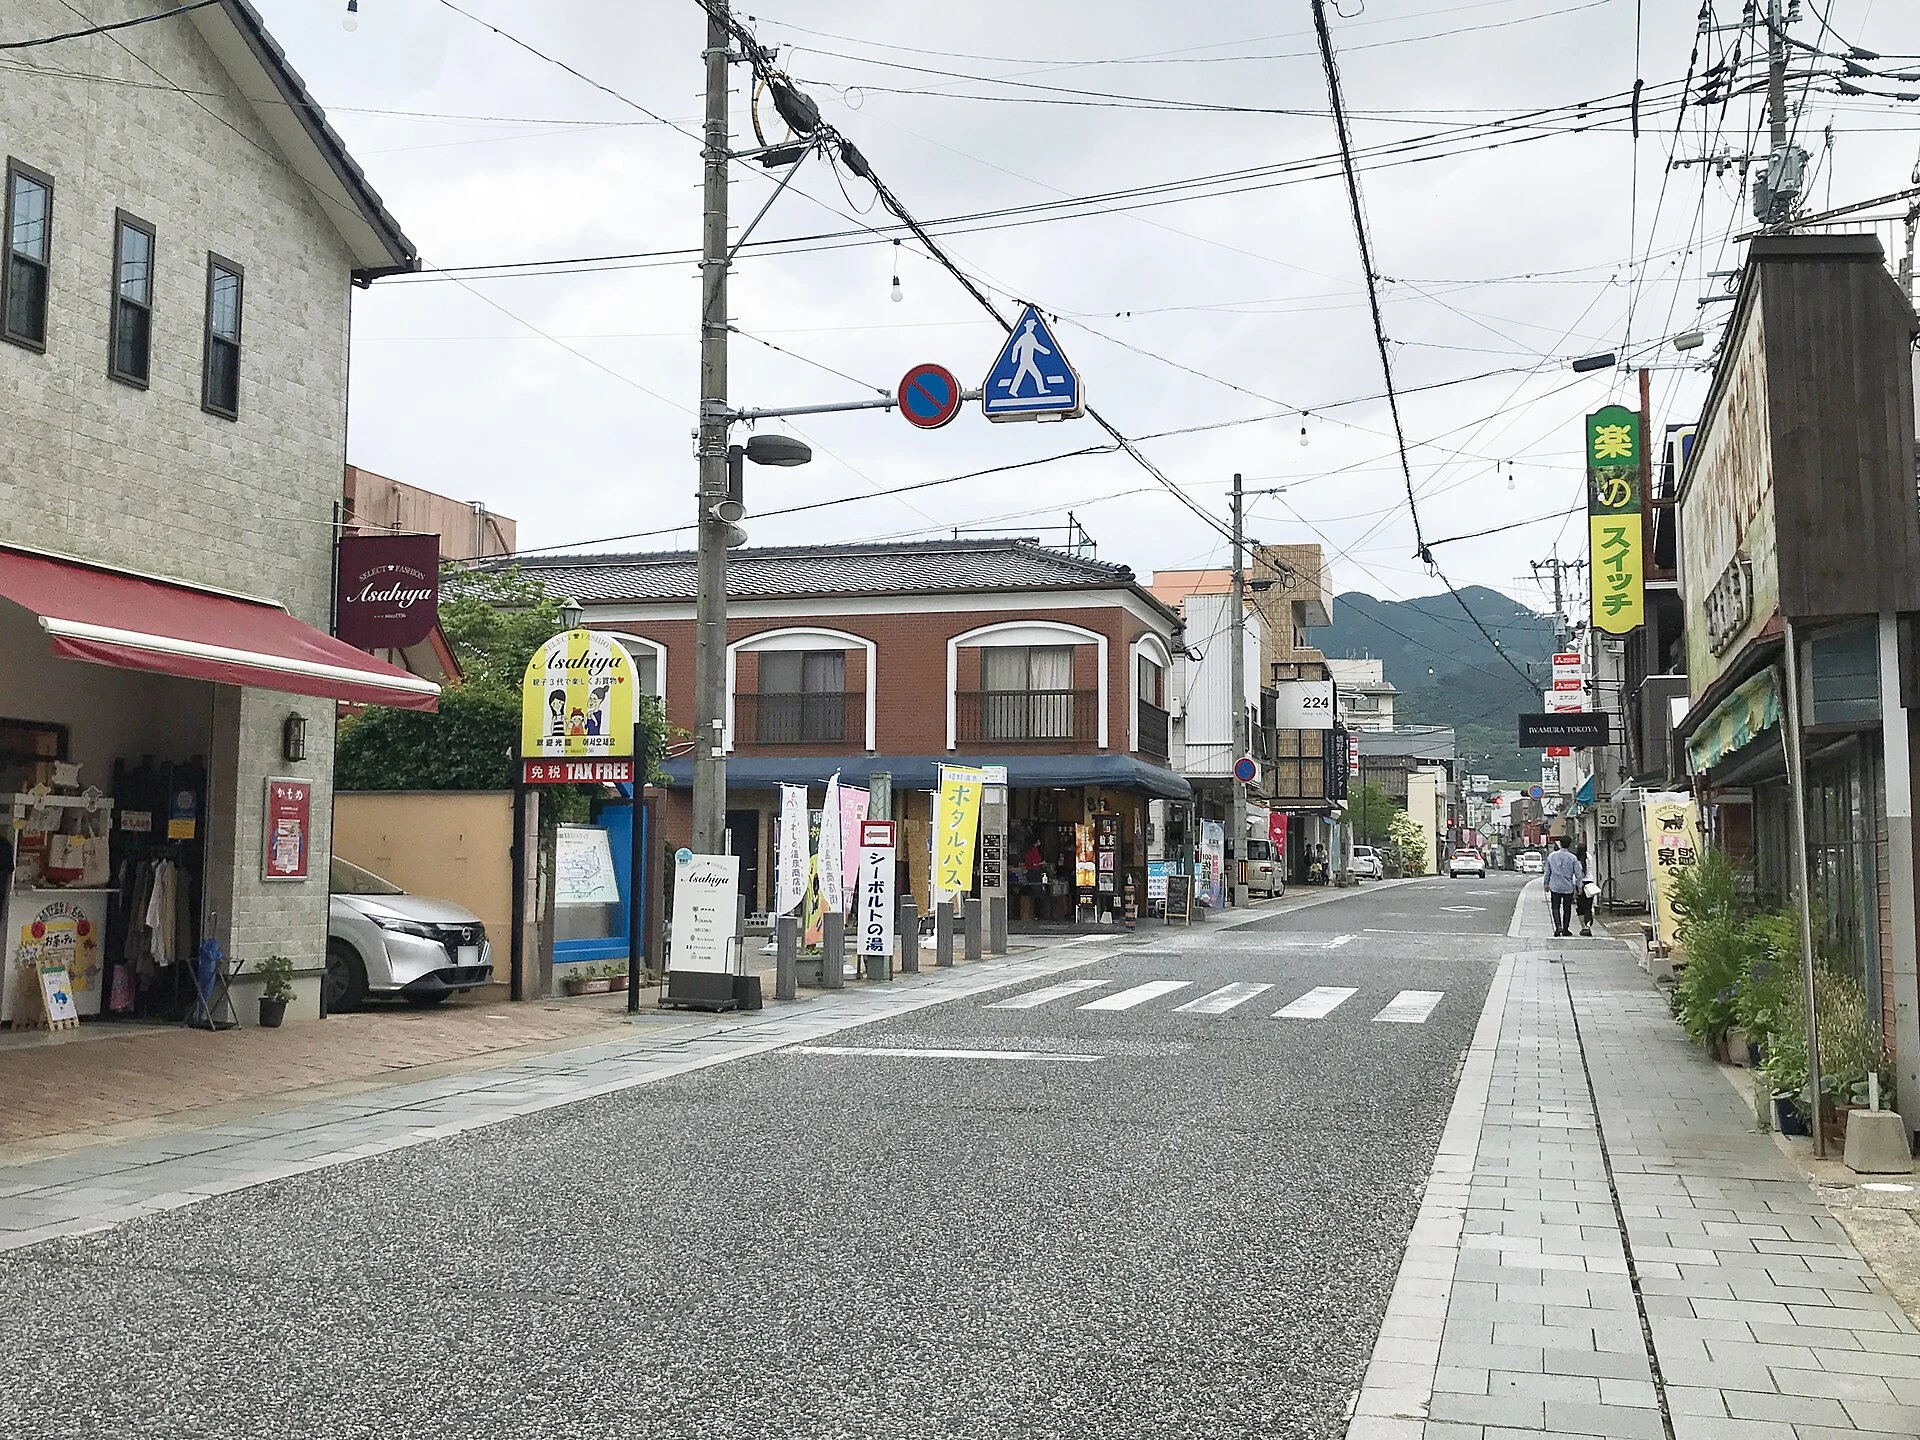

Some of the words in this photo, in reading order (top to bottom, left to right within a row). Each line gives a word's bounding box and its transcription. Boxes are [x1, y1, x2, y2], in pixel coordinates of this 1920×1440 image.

[1594, 424, 1633, 617] 楽のスイッチ
[359, 565, 387, 581] SELECT
[395, 565, 426, 580] FASHION
[346, 581, 433, 609] Asahiya
[544, 633, 571, 652] SELECT
[581, 632, 615, 652] FASHION
[532, 649, 622, 677] Asahiya
[1302, 696, 1330, 709] 224
[1528, 726, 1566, 734] IWAMURA
[1567, 726, 1598, 734] TOKOYA
[531, 765, 561, 779] 免税
[566, 763, 593, 780] TAX
[595, 762, 629, 780] FREE
[1600, 815, 1617, 825] 30
[943, 785, 971, 886] ホタルバス
[680, 871, 730, 888] Asahiya
[865, 852, 886, 952] シーボルトの湯
